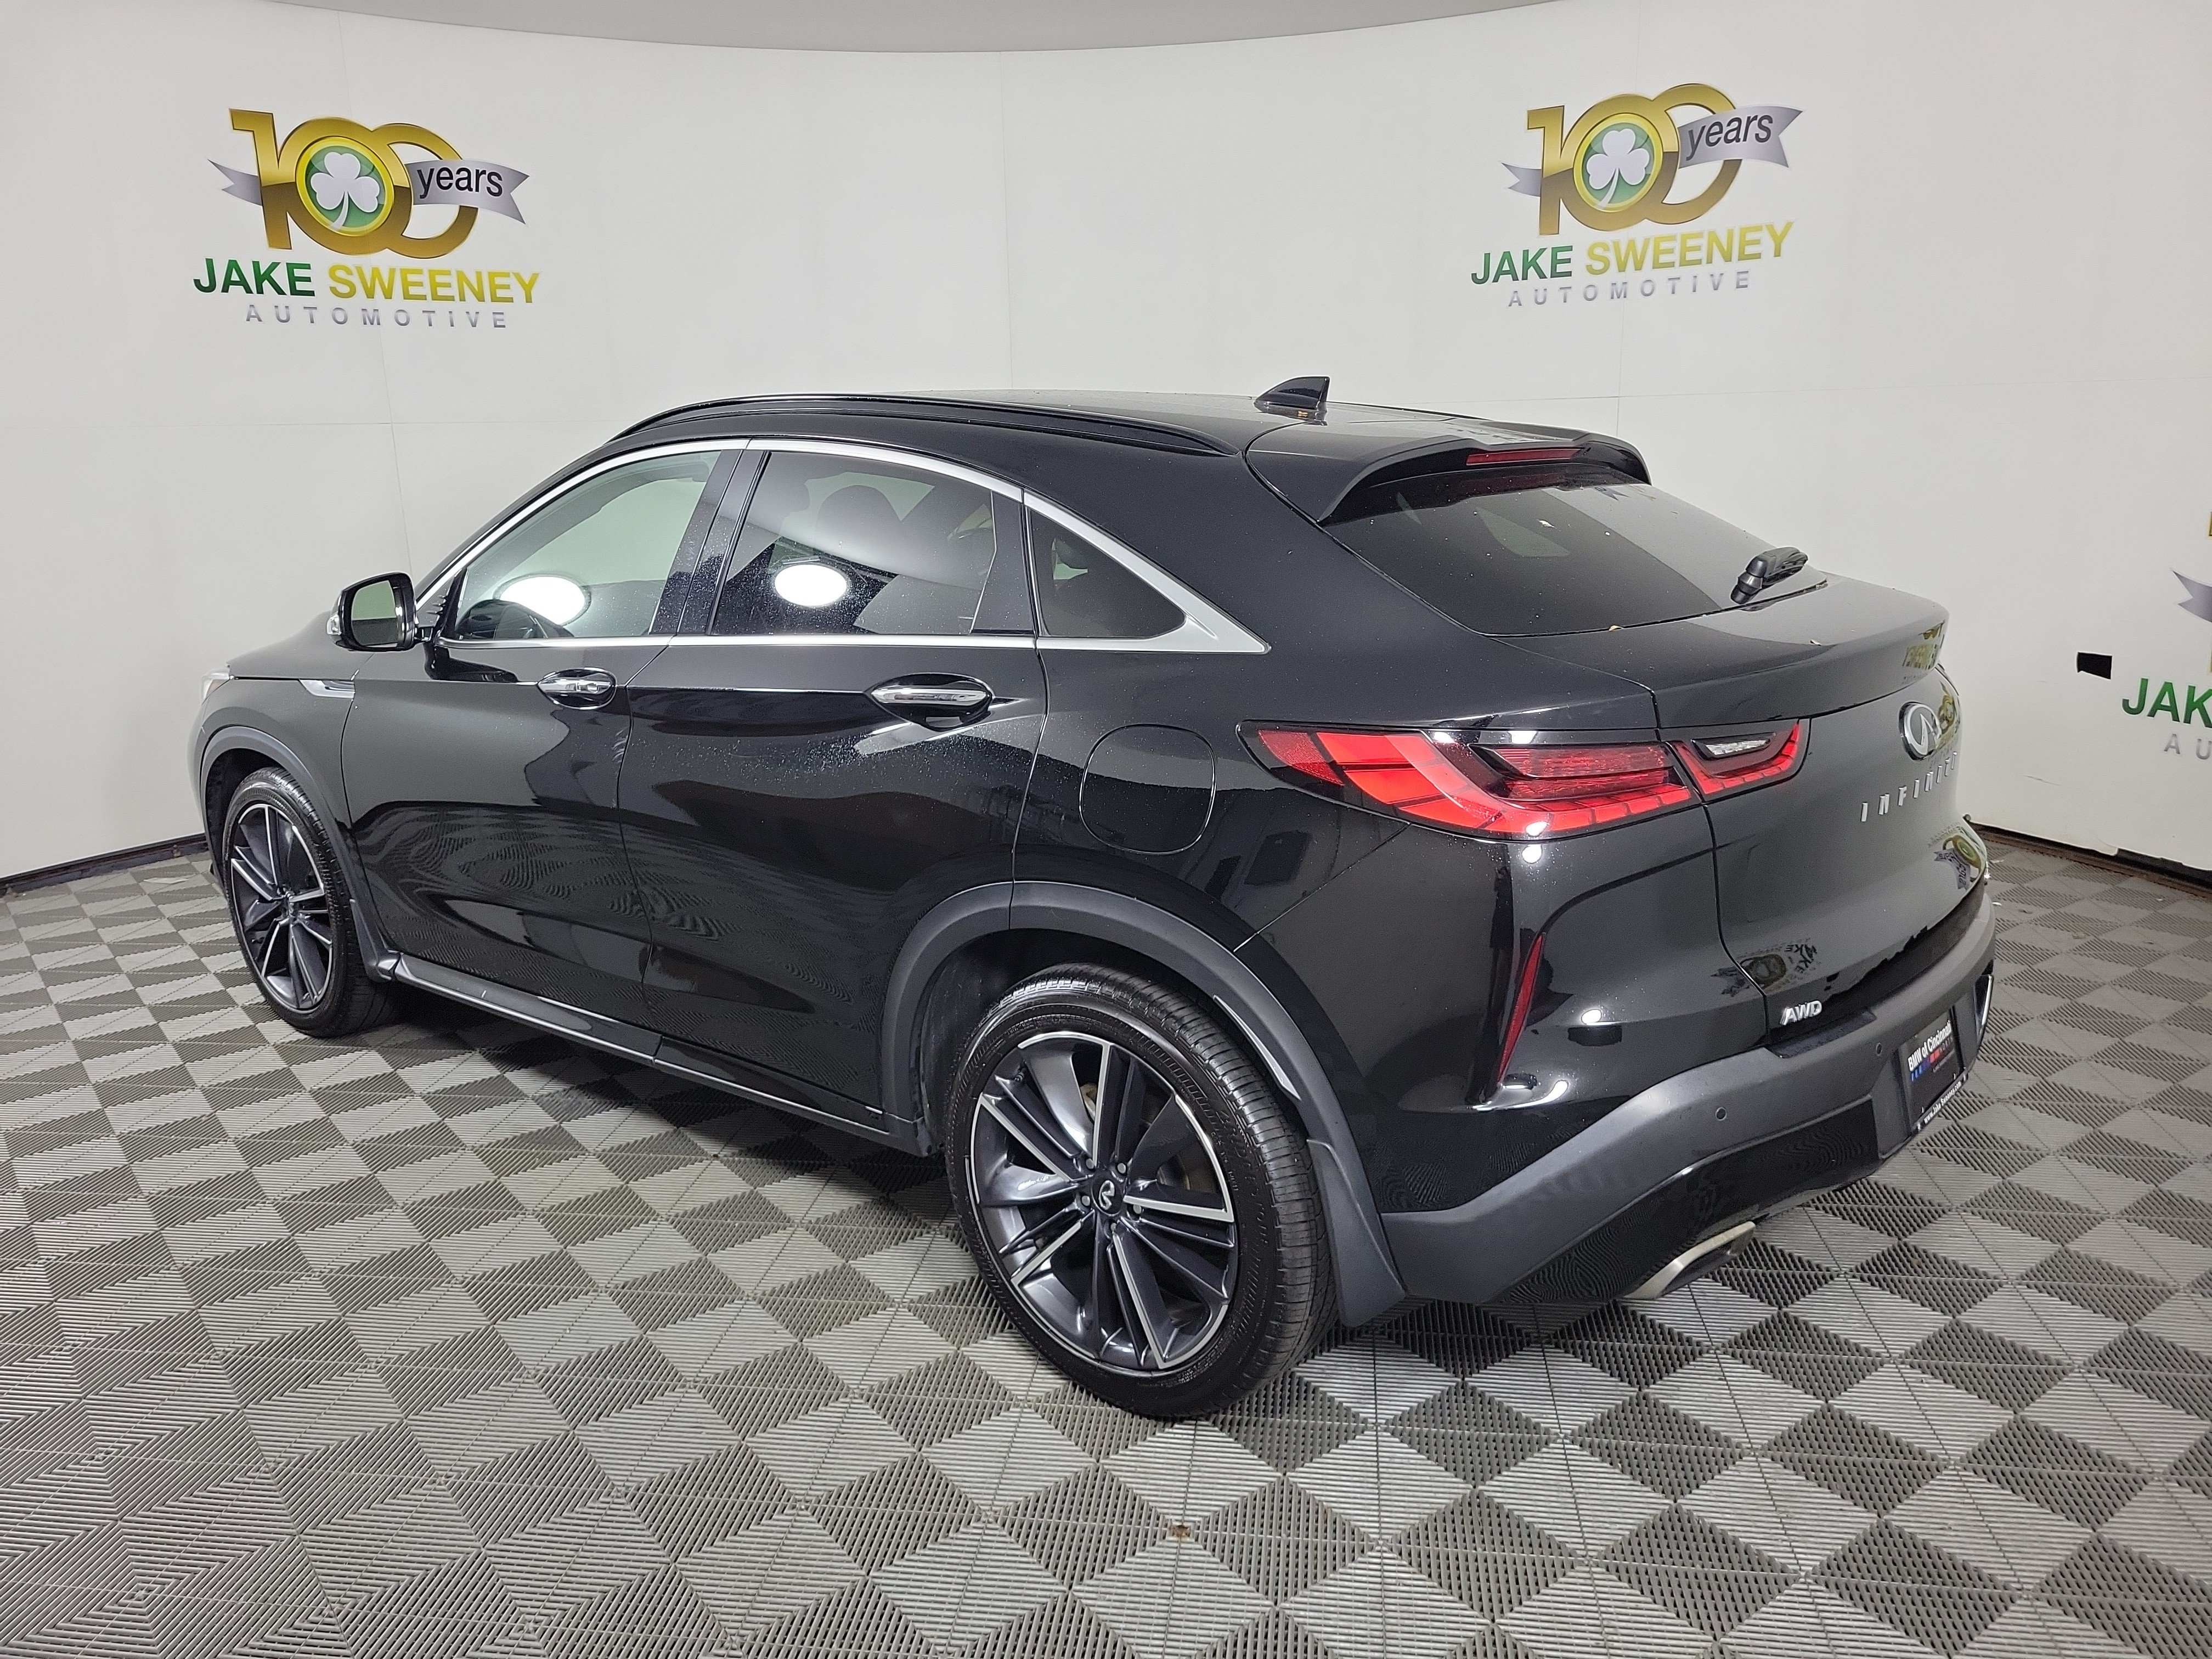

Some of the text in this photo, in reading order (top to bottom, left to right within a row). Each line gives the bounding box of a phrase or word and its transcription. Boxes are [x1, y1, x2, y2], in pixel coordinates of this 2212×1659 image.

[229, 108, 503, 258] 100 years
[1527, 83, 1773, 235] 100 years
[1471, 221, 1794, 284] JAKE SWEENEY
[193, 258, 541, 303] JAKE SWEENEY
[1508, 270, 1749, 307] AUTOMOTIVE
[246, 304, 506, 328] AUTOMOTIVE
[1780, 1000, 1822, 1025] AWD
[1908, 1047, 1922, 1071] BMW
[1921, 1041, 1928, 1058] of
[1927, 1019, 1952, 1052] Cincinnati
